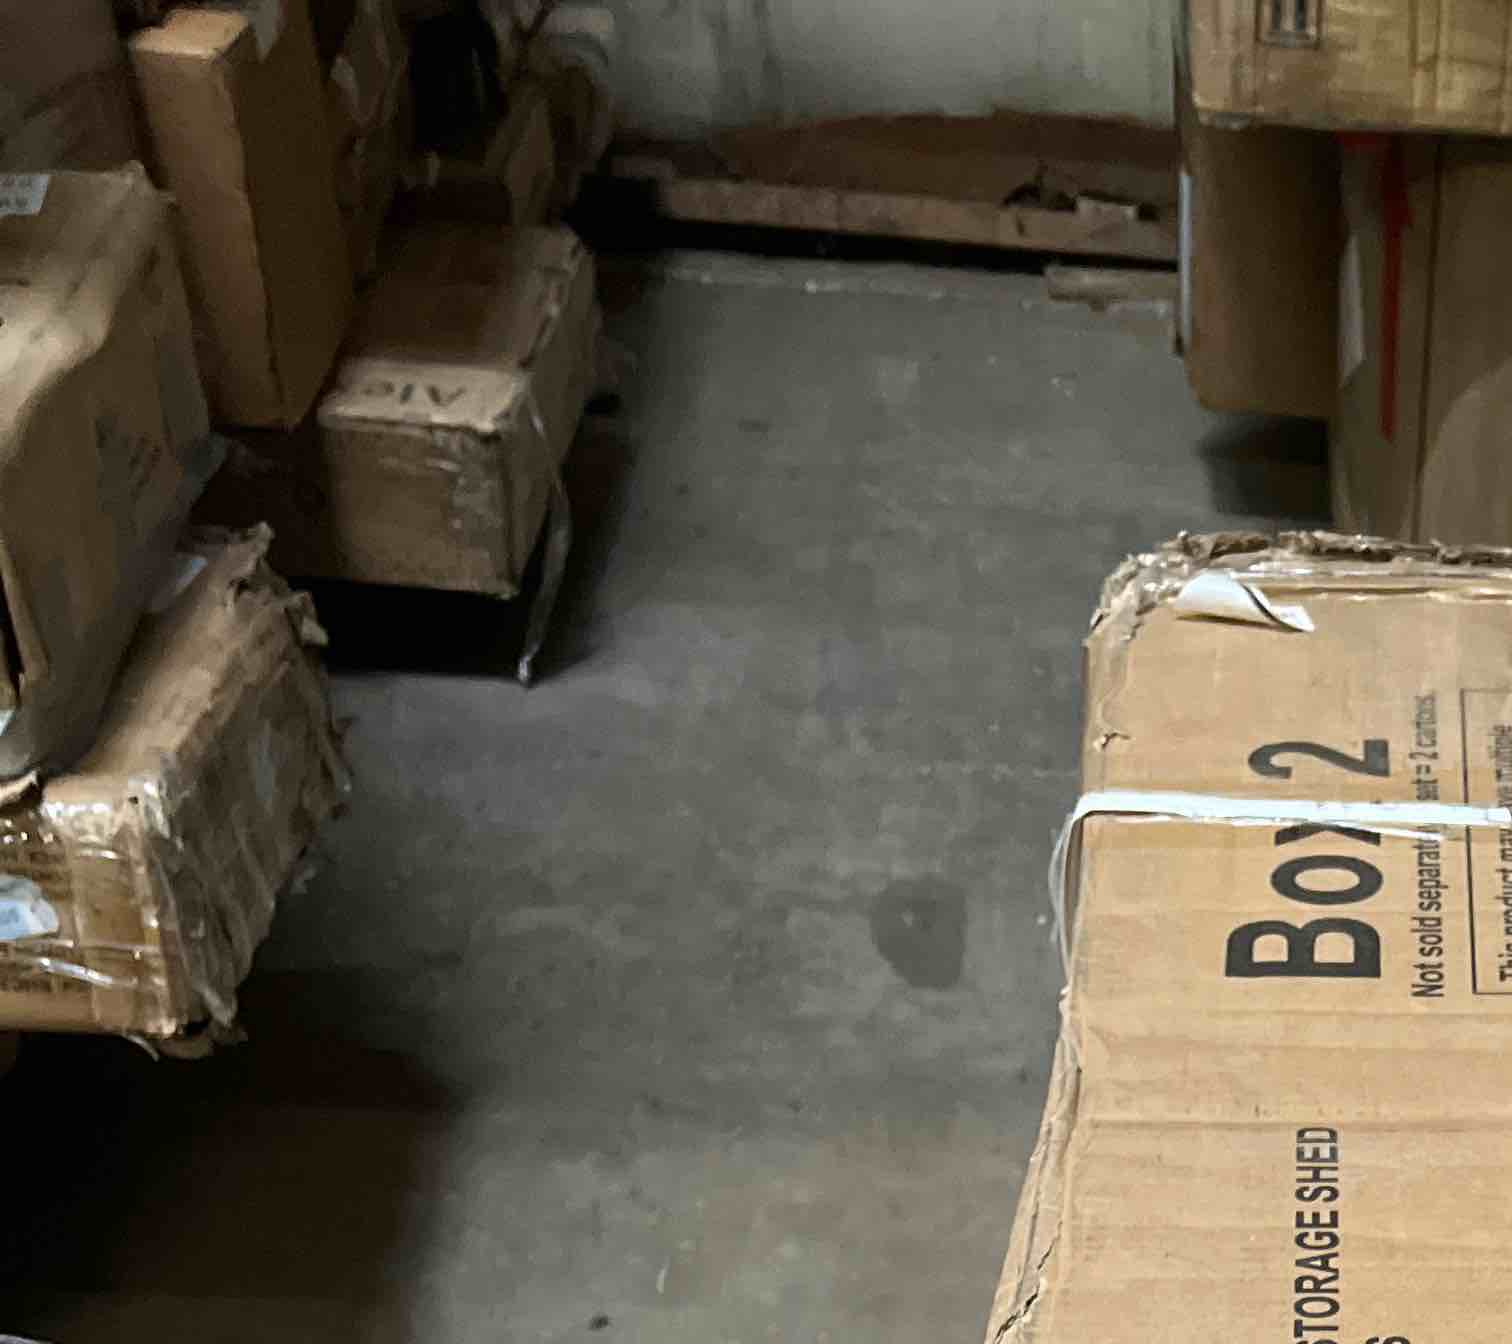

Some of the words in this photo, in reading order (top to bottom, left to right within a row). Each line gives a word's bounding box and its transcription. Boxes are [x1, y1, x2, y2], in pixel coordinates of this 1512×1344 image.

[1247, 737, 1392, 782] 2
[1225, 802, 1384, 979] Box
[1410, 915, 1444, 958] sold
[1411, 962, 1445, 998] Not
[1294, 1126, 1340, 1203] SHED
